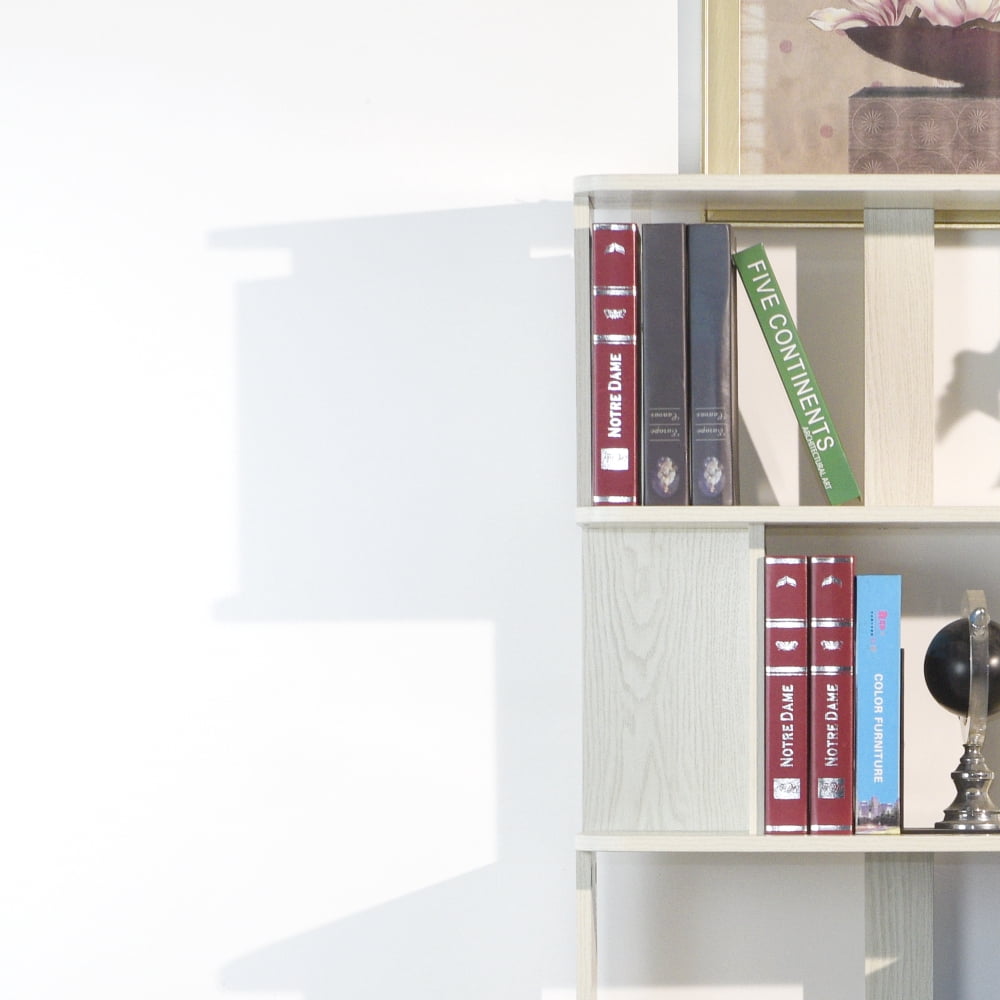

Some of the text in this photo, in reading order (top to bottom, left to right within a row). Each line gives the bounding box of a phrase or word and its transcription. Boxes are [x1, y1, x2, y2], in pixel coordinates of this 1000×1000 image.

[608, 353, 622, 438] NOTRE DAME
[747, 260, 834, 452] FIVE CONTINENTS
[802, 426, 833, 490] ARCHITECTURAL ART
[780, 684, 794, 767] NOTRE DAME
[824, 683, 838, 767] NOTRE DAME
[873, 674, 883, 784] COLOR FURNITURE
